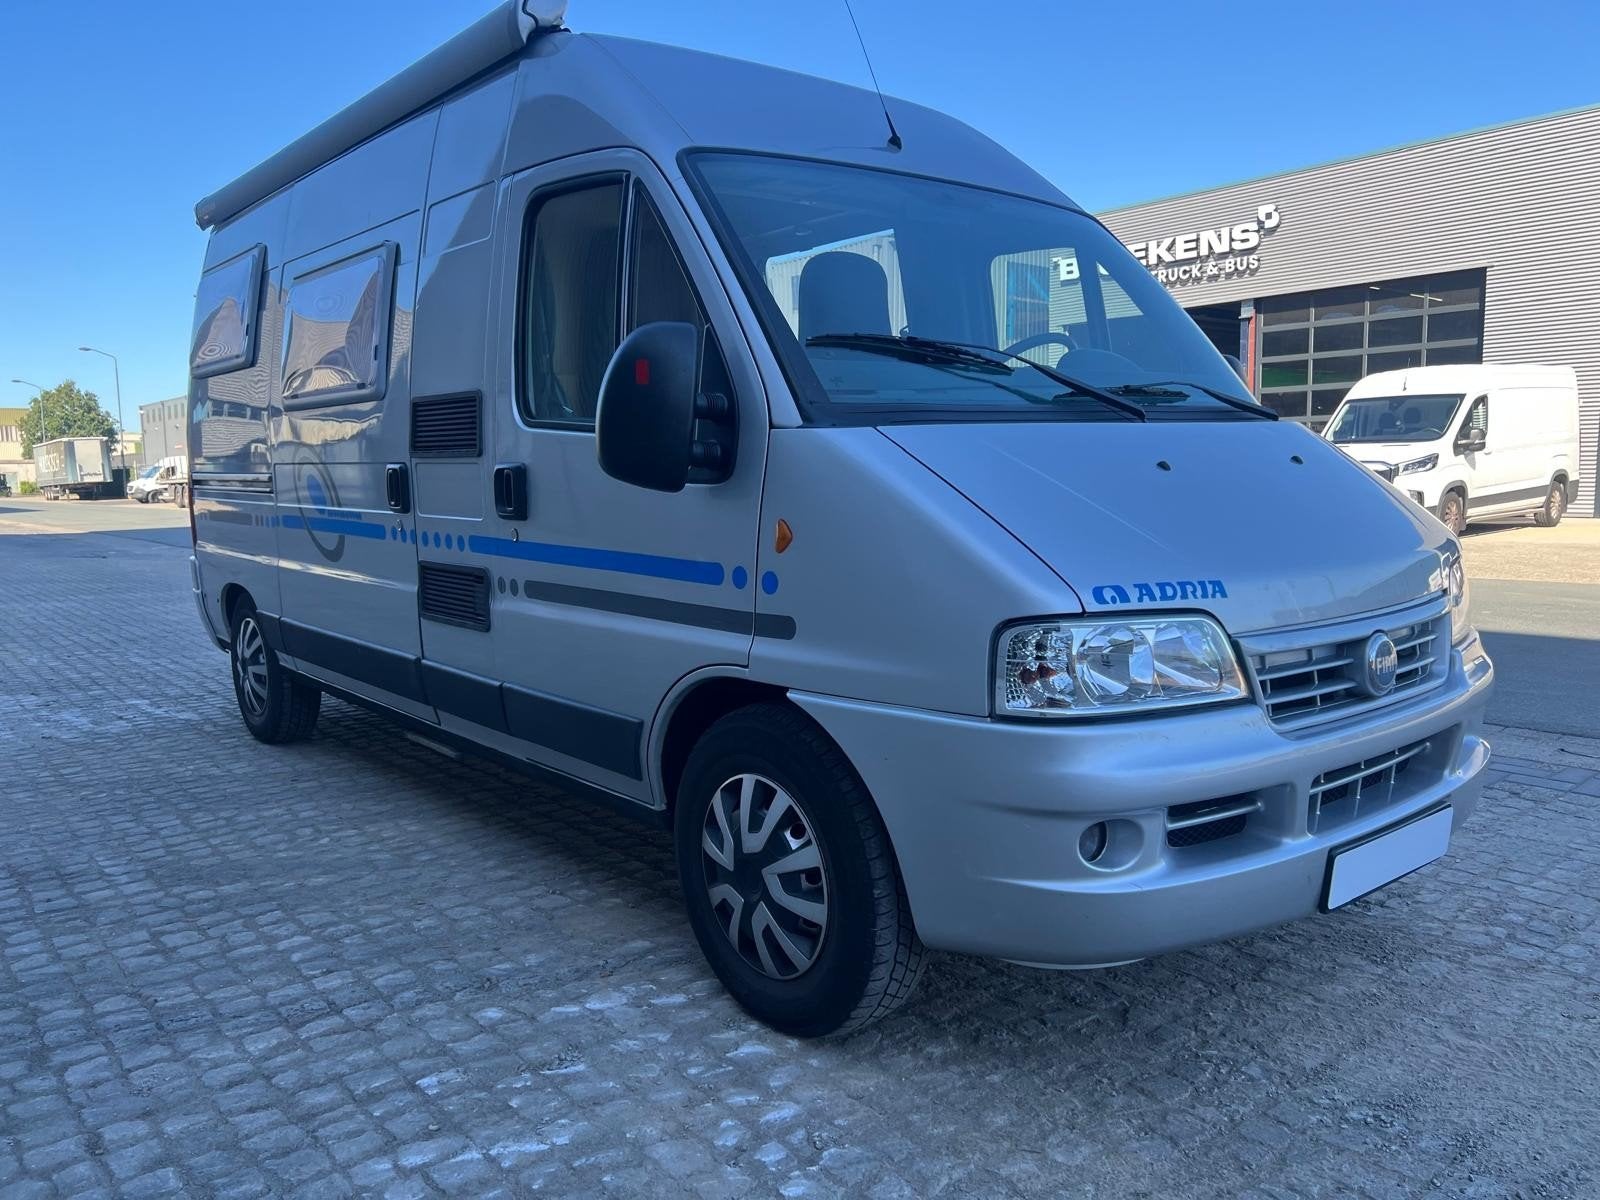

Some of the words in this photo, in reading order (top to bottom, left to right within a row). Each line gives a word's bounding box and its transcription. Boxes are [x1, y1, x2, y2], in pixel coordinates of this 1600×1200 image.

[1206, 261, 1219, 275] &
[1225, 255, 1259, 273] BUS
[1133, 580, 1228, 603] ADRIA
